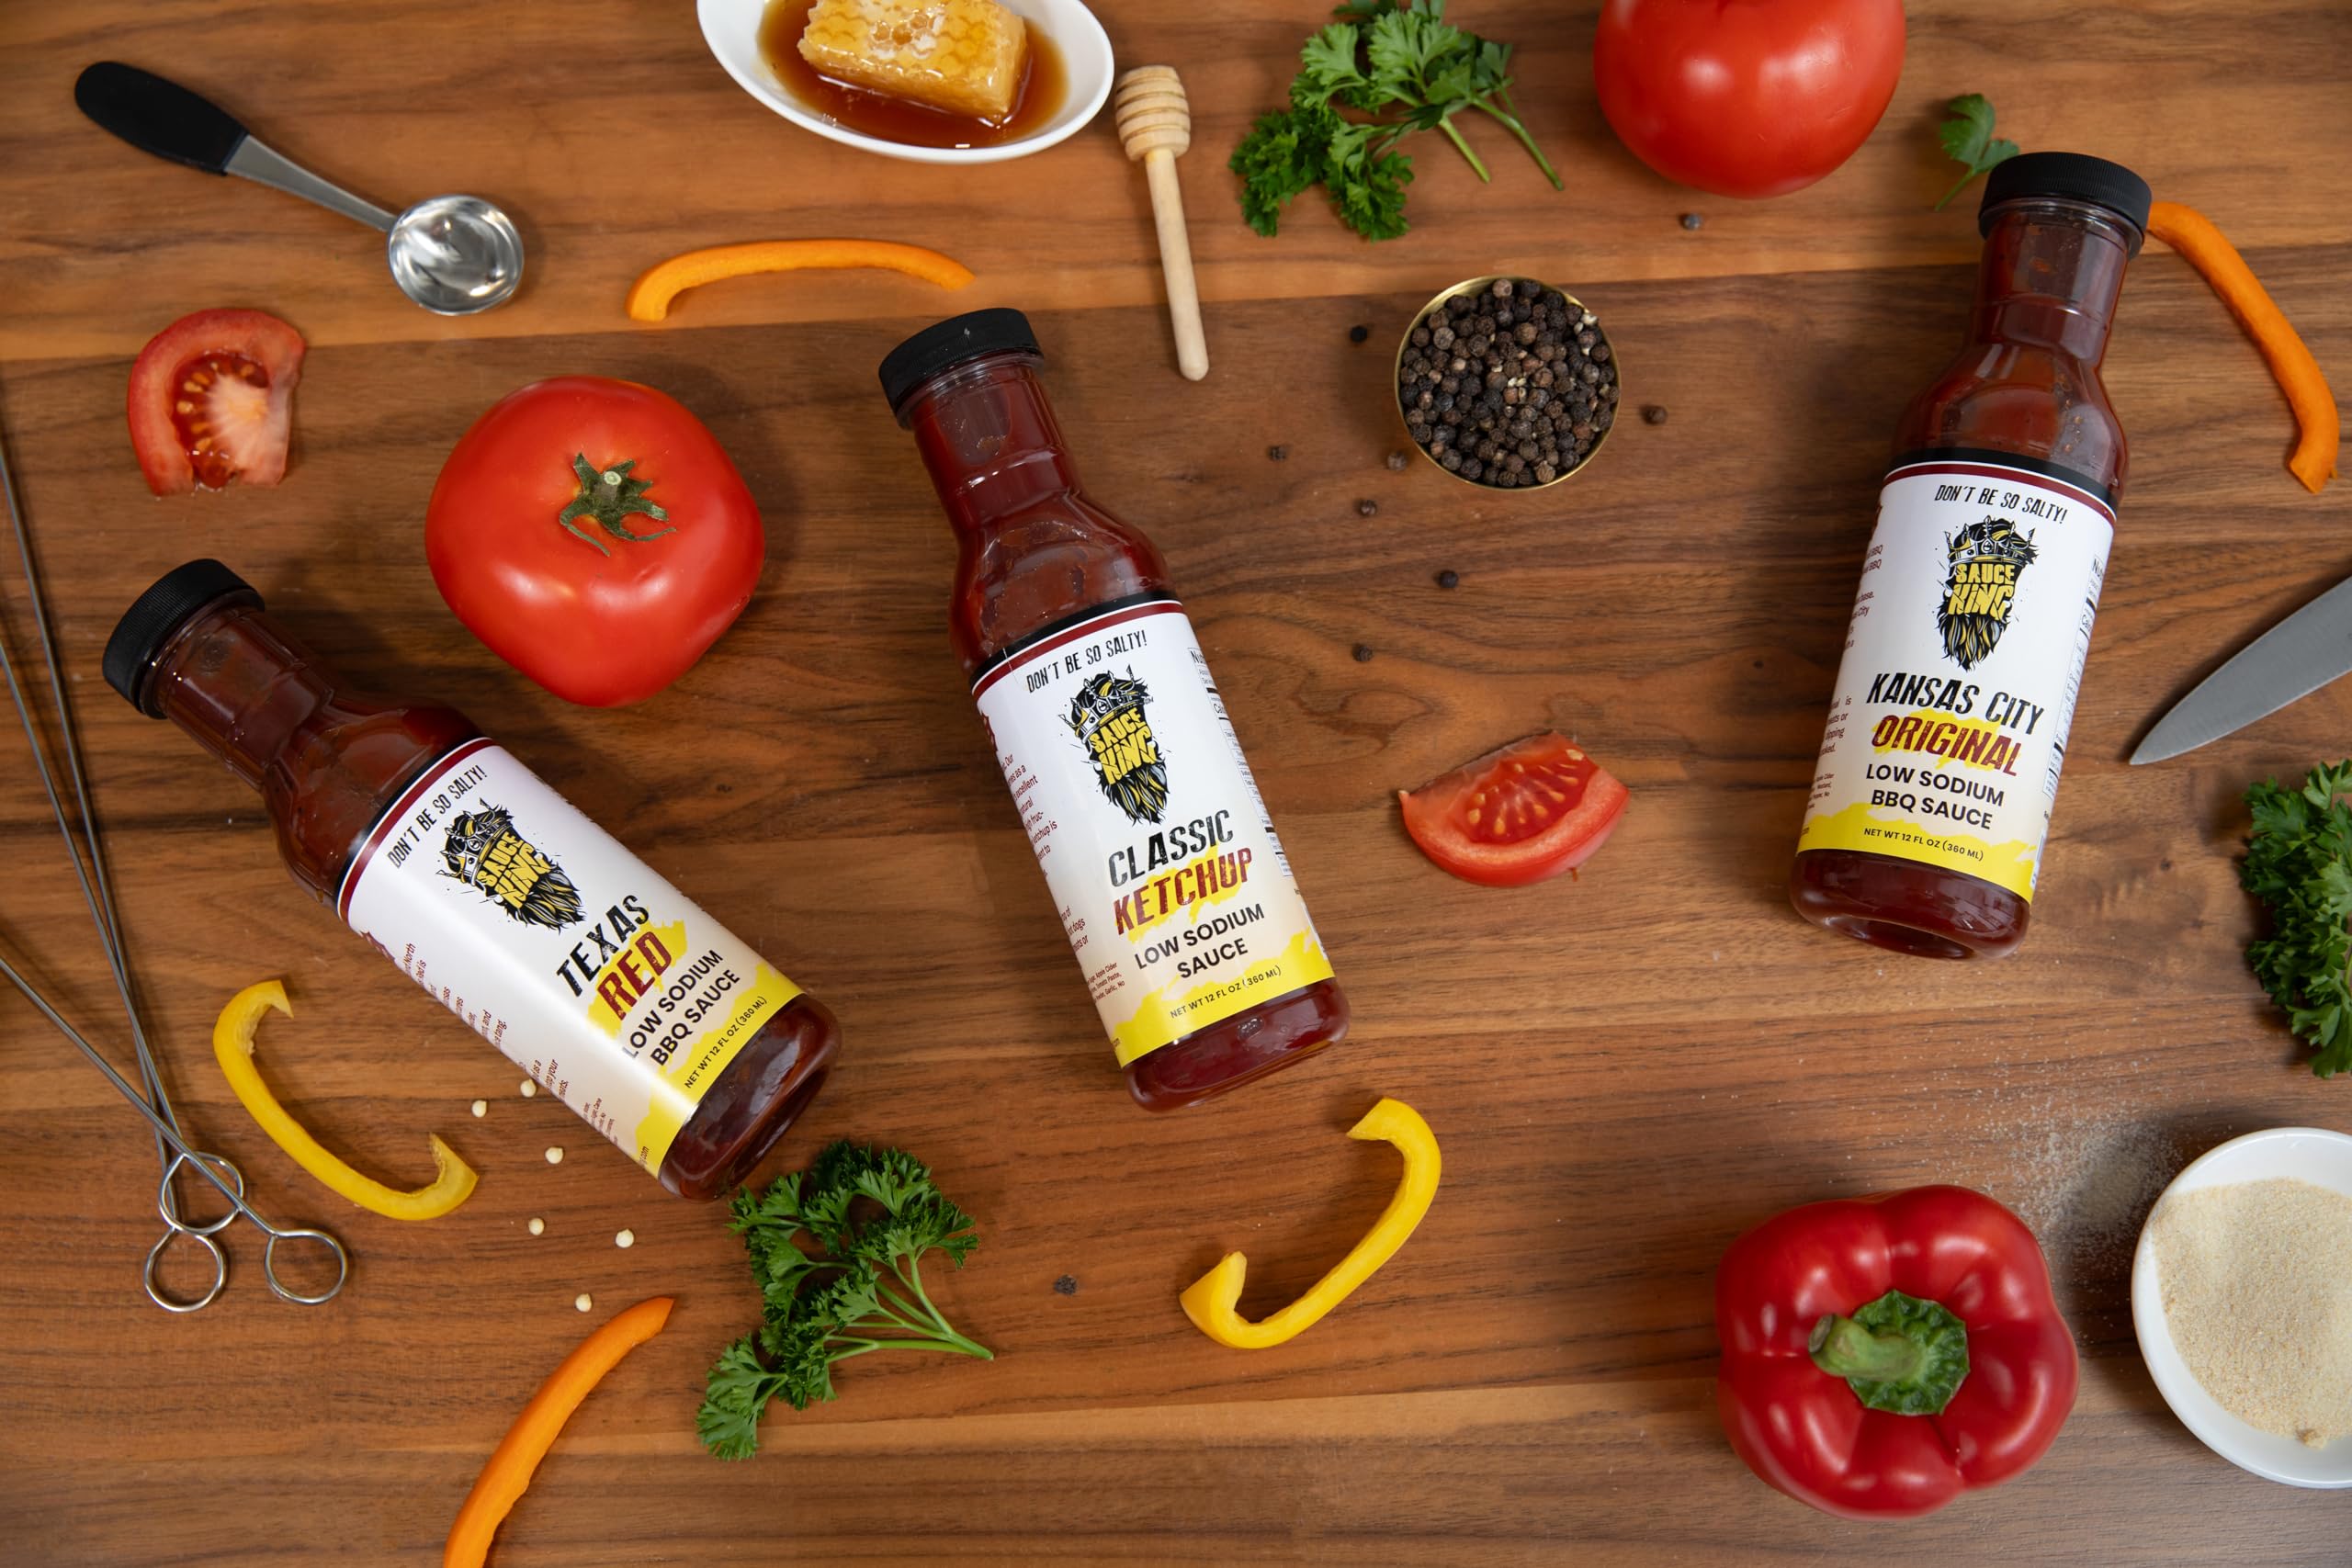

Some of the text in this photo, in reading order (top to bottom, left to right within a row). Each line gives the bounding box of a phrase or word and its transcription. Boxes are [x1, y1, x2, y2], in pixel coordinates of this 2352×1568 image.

[1977, 488, 1998, 506] BE
[2000, 491, 2020, 509] SO
[2021, 497, 2068, 525] SALTY!
[1955, 563, 2015, 585] SAUCE
[1064, 652, 1082, 673] BE
[1086, 645, 1102, 665] SO
[1105, 629, 1148, 658] SALTY!
[1090, 707, 1146, 752] SAUCE
[1866, 672, 1980, 715] KANSAS
[1984, 692, 2044, 735] CITY
[1871, 715, 2021, 777] ORIGINAL
[415, 809, 437, 831] BE
[433, 794, 452, 815] SO
[448, 764, 488, 800] SALTY!
[1866, 764, 2005, 807] LOW SODIUM
[1871, 790, 1993, 829] BBQ SAUCE
[477, 831, 521, 887] SAUCE
[1108, 809, 1233, 887] CLASSIC
[1864, 828, 1984, 862] NET WT 12 FL OZ (360 ML)
[1113, 847, 1252, 935] KETCHUP
[556, 895, 650, 998] TEXAS
[1134, 903, 1265, 970] LOW SODIUM
[1177, 938, 1249, 979] SAUCE
[597, 931, 672, 1021] RED
[622, 950, 724, 1059] LOW SODIUM
[1170, 965, 1282, 1019] NET WT 12 FL OZ (360 ML)
[650, 969, 741, 1066] BBQ SAUCE
[684, 996, 768, 1089] NET WT 12 FL OZ (360 ML)
